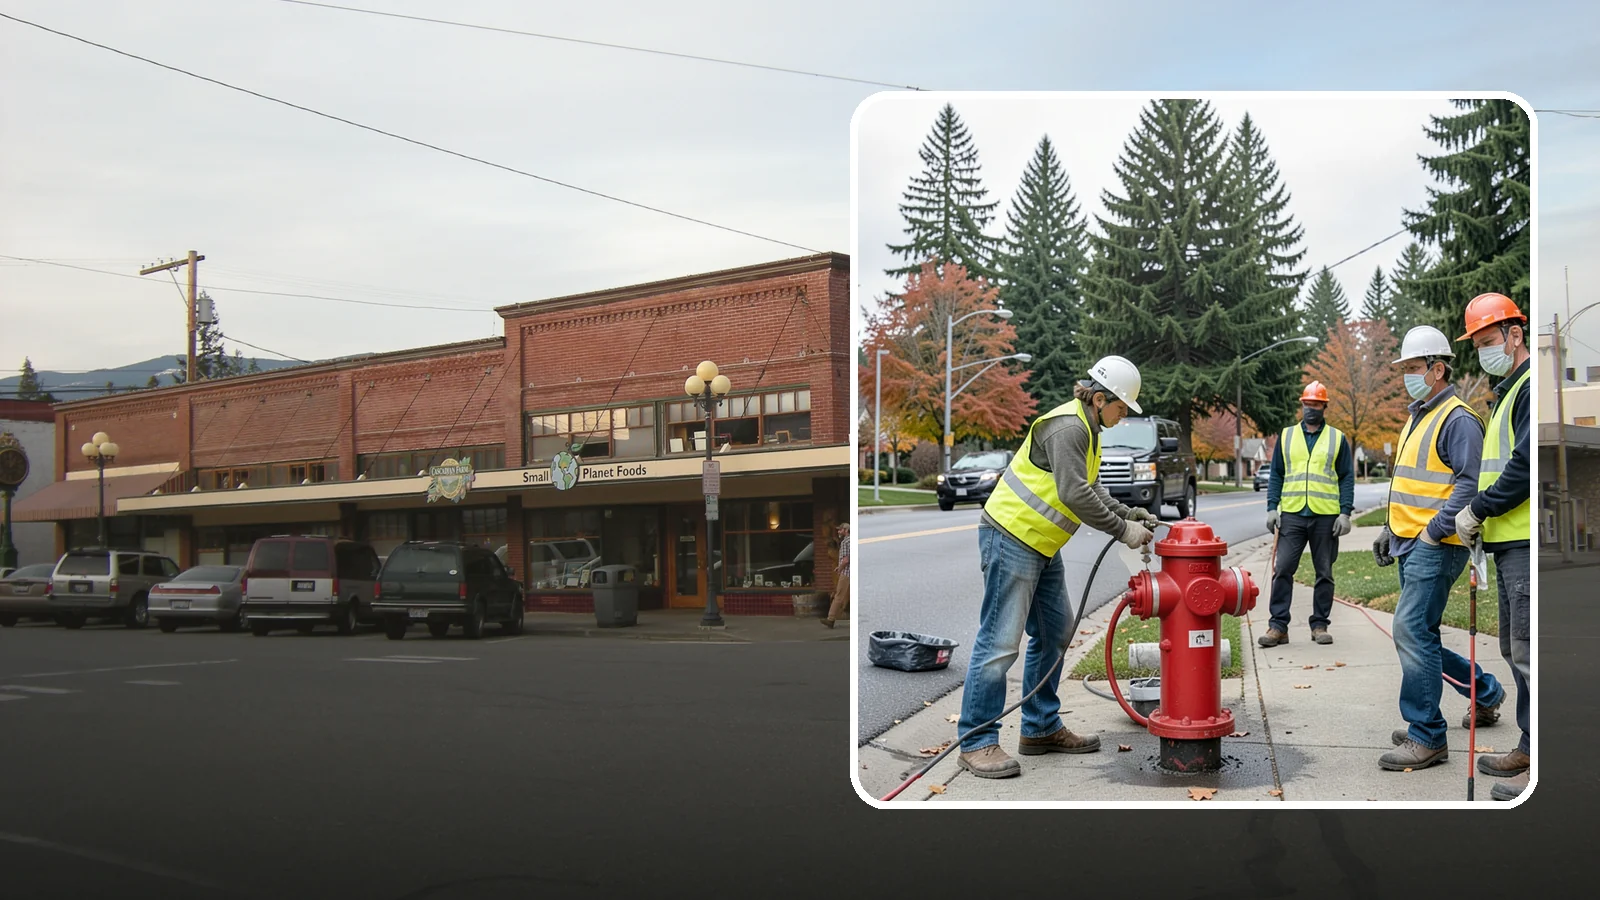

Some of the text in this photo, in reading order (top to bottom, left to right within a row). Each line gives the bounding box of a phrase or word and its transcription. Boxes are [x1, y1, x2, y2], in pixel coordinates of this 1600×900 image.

[523, 464, 647, 483] Small Planet Foods
